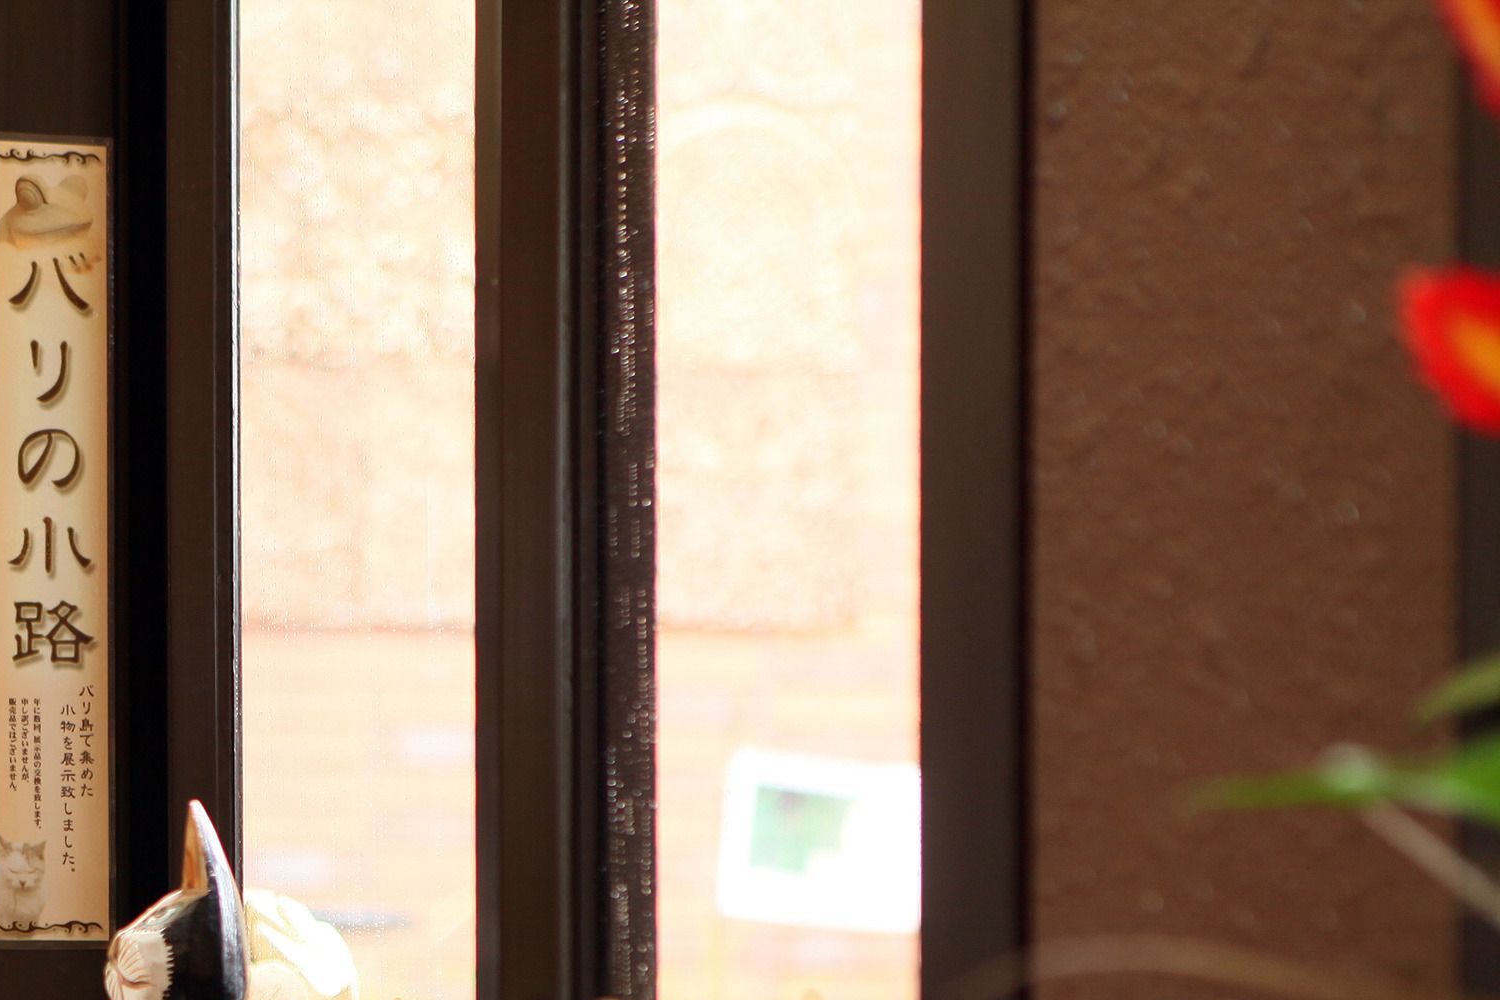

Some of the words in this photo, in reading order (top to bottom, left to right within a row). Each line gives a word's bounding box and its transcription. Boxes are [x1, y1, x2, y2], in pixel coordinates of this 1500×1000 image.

[8, 250, 96, 664] バリの小路
[60, 703, 76, 873] 小物を展示致しました。
[79, 684, 95, 798] バリ島で集めた
